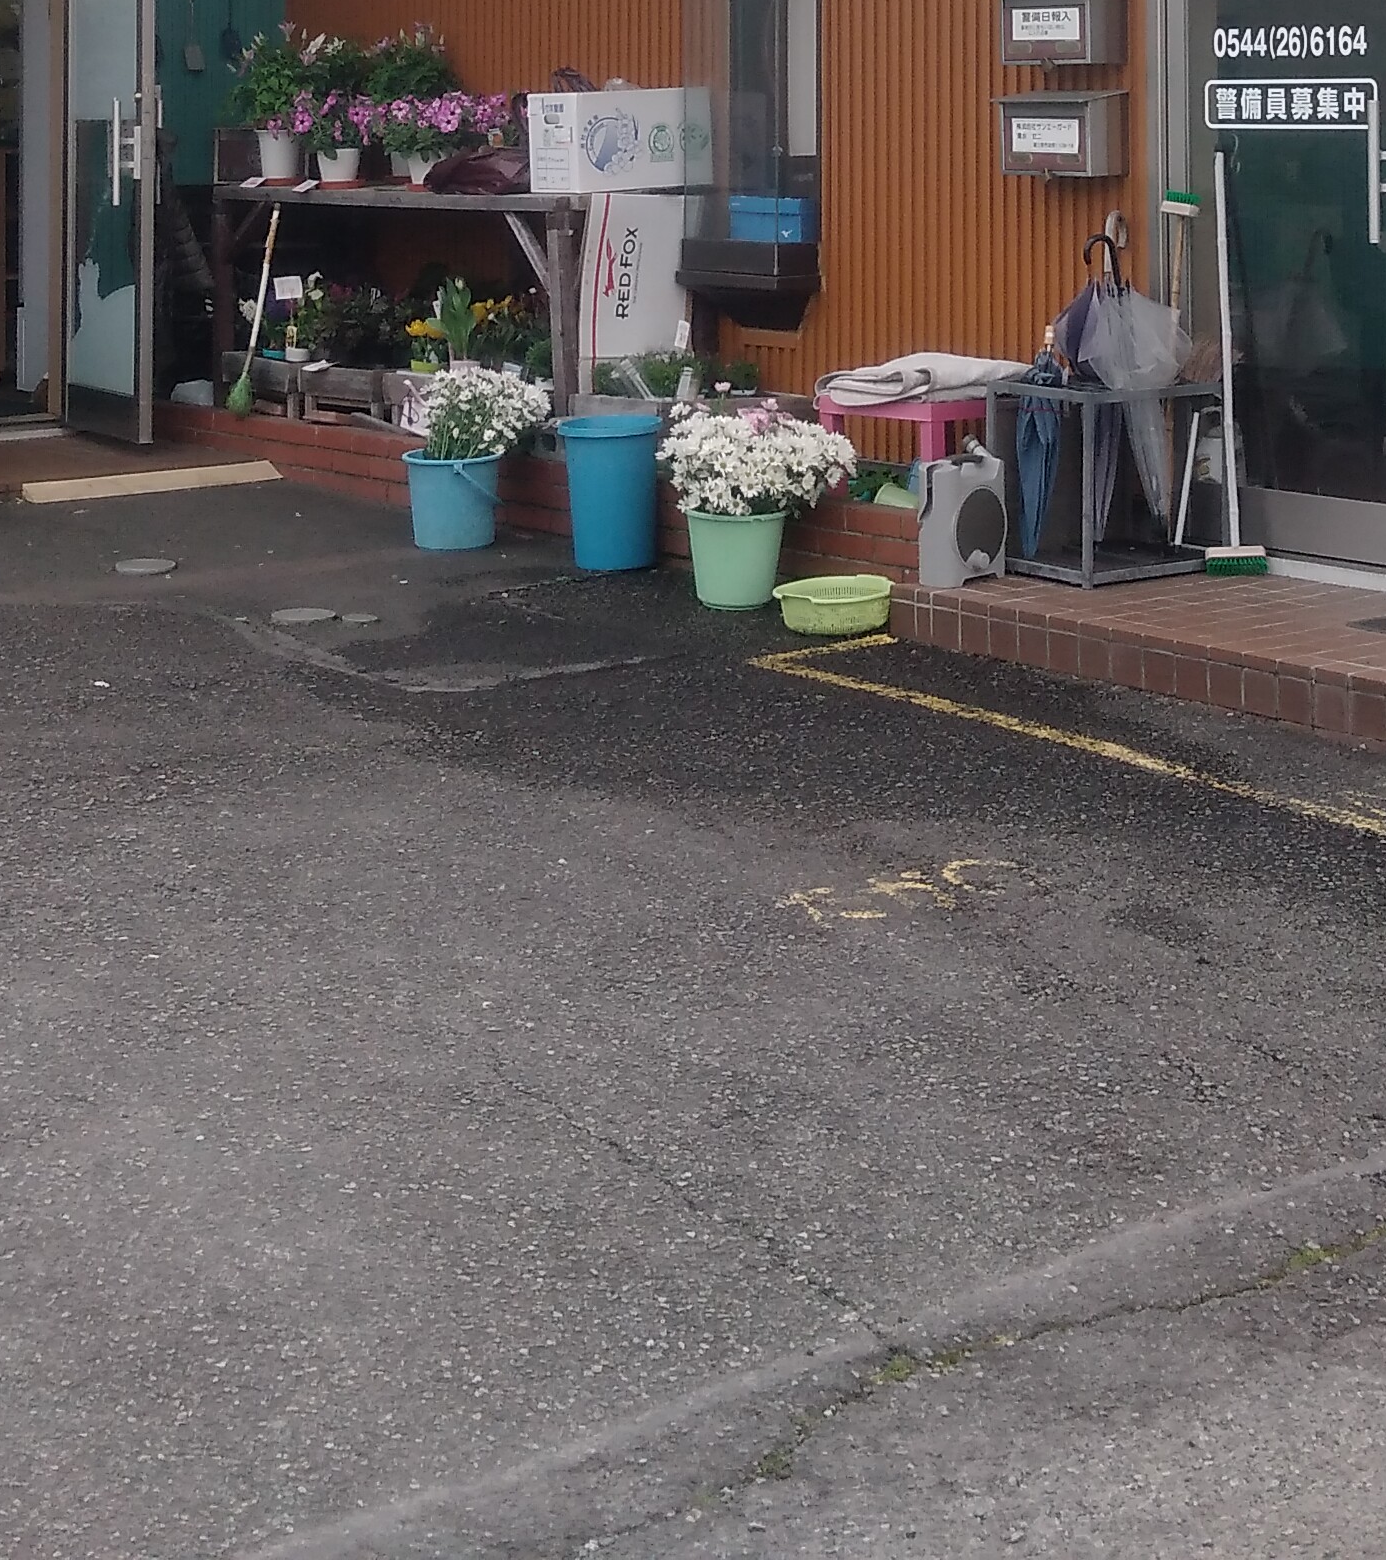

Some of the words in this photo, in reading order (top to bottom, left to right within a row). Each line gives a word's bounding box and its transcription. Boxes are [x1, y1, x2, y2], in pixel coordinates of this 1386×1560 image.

[1214, 25, 1368, 59] 0544(26)6164
[1216, 87, 1365, 120] 警備員募集中
[620, 227, 639, 268] FOX
[616, 273, 632, 319] RED
